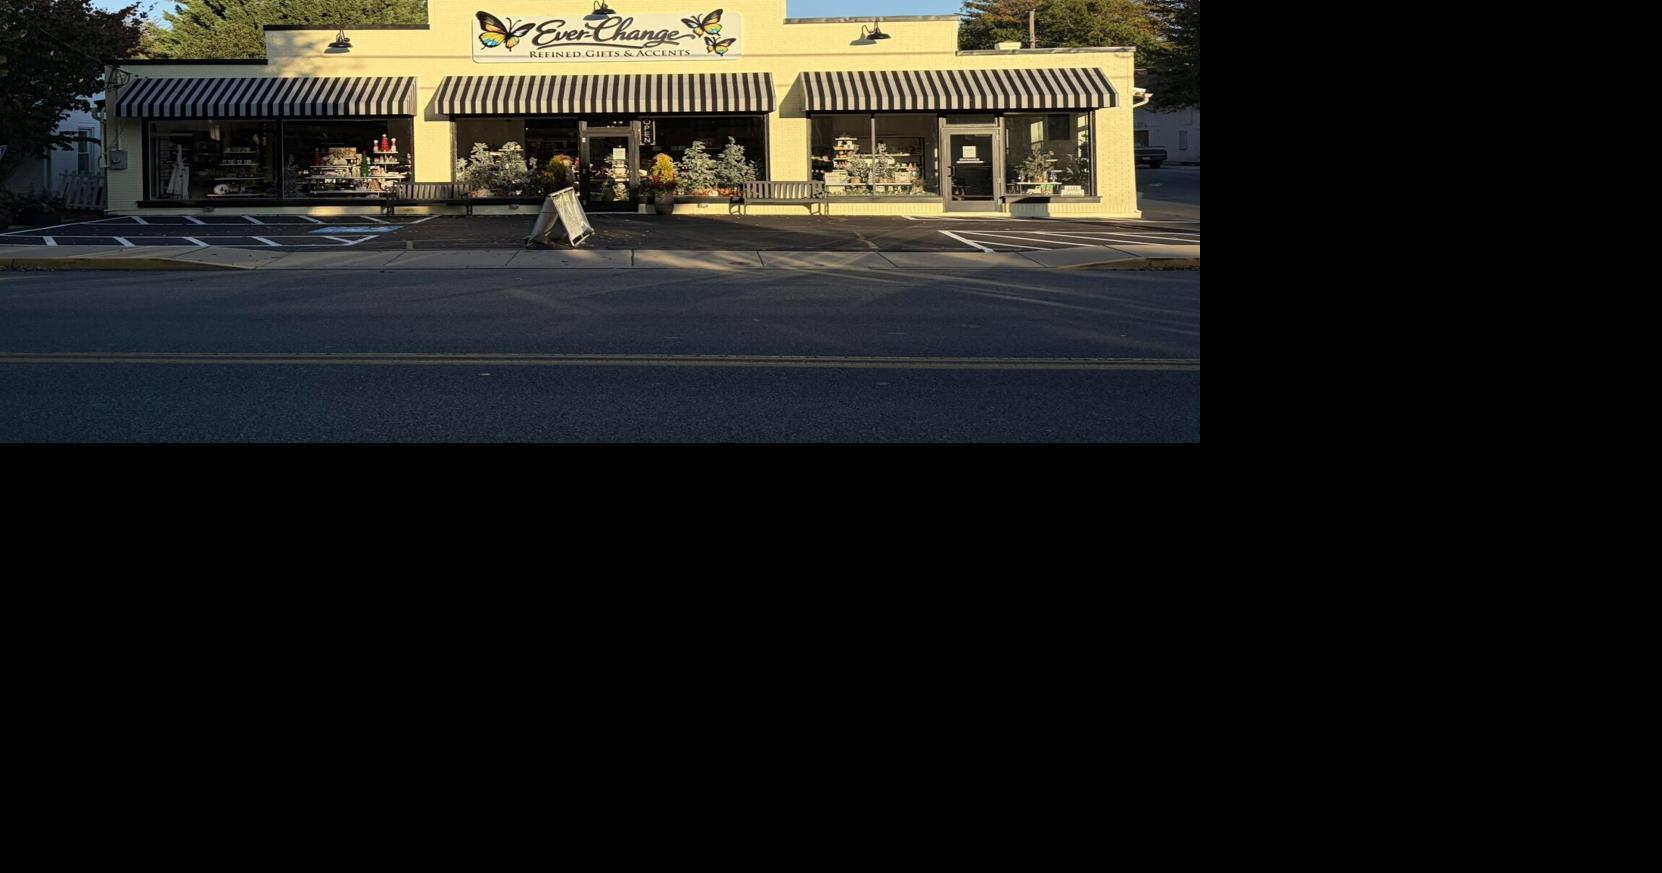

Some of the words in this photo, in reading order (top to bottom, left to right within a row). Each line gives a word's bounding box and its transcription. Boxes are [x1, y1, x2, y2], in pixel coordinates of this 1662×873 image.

[531, 16, 696, 48] Ever-Change
[529, 50, 581, 58] REFINED
[585, 50, 620, 58] GIFTS
[623, 49, 632, 57] &
[636, 49, 690, 57] ACCENTS
[642, 119, 651, 143] OPEN
